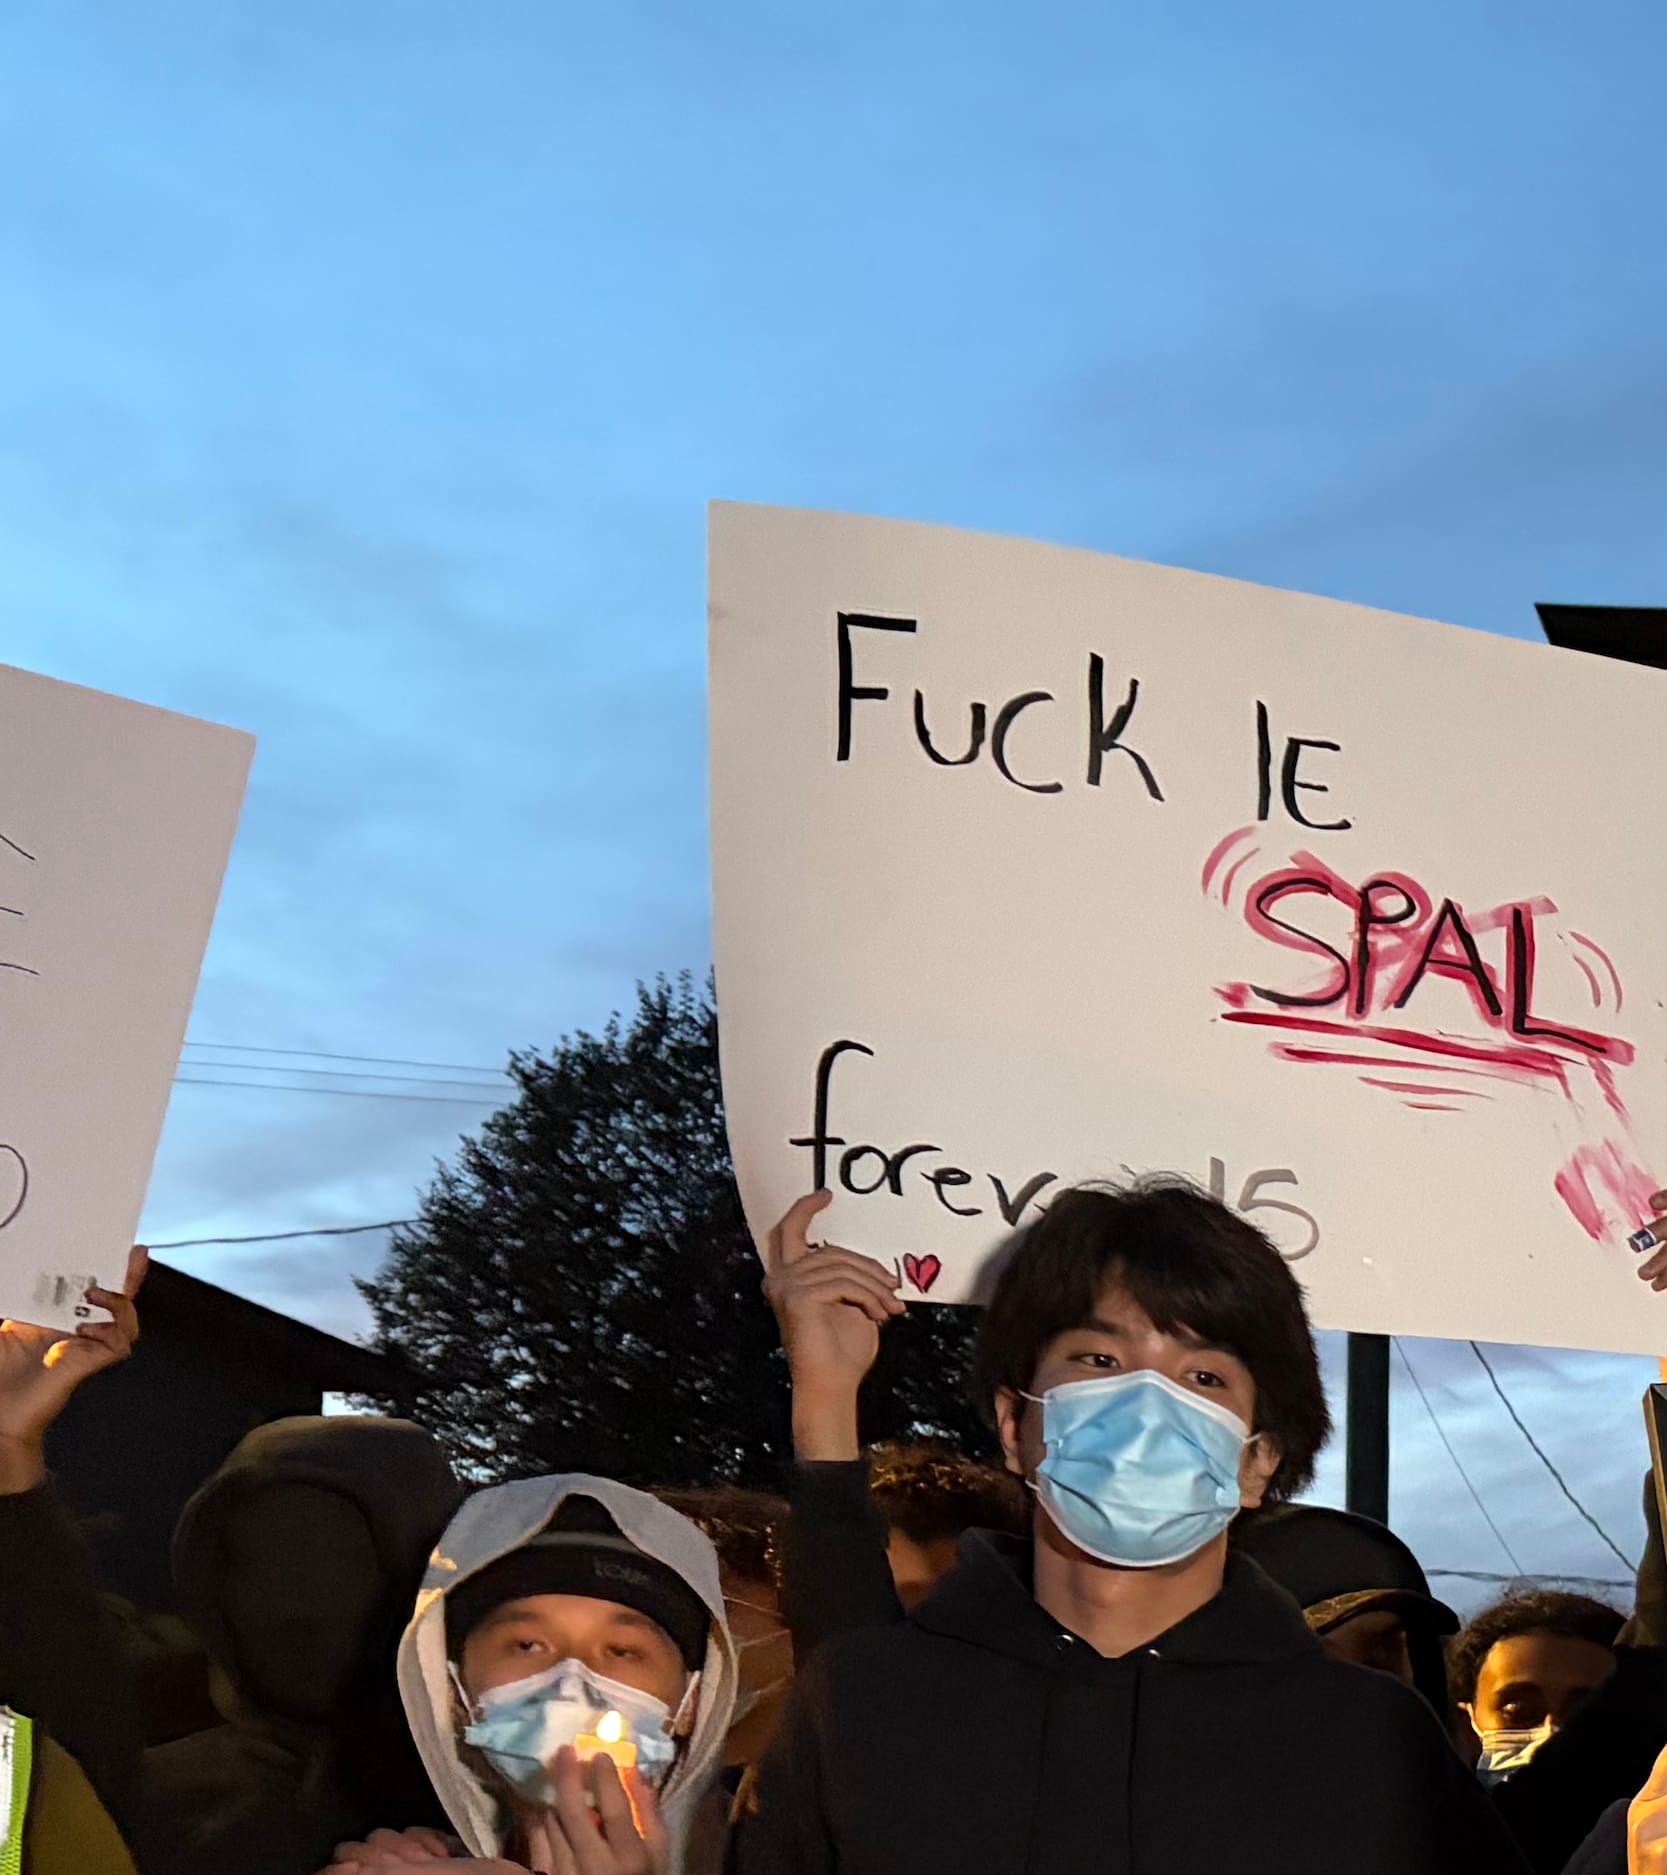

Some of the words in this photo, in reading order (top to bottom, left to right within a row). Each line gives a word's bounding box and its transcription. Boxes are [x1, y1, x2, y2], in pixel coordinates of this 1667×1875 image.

[836, 611, 1165, 802] Fuck
[1243, 866, 1632, 1064] SPAL
[788, 1039, 1059, 1227] forev
